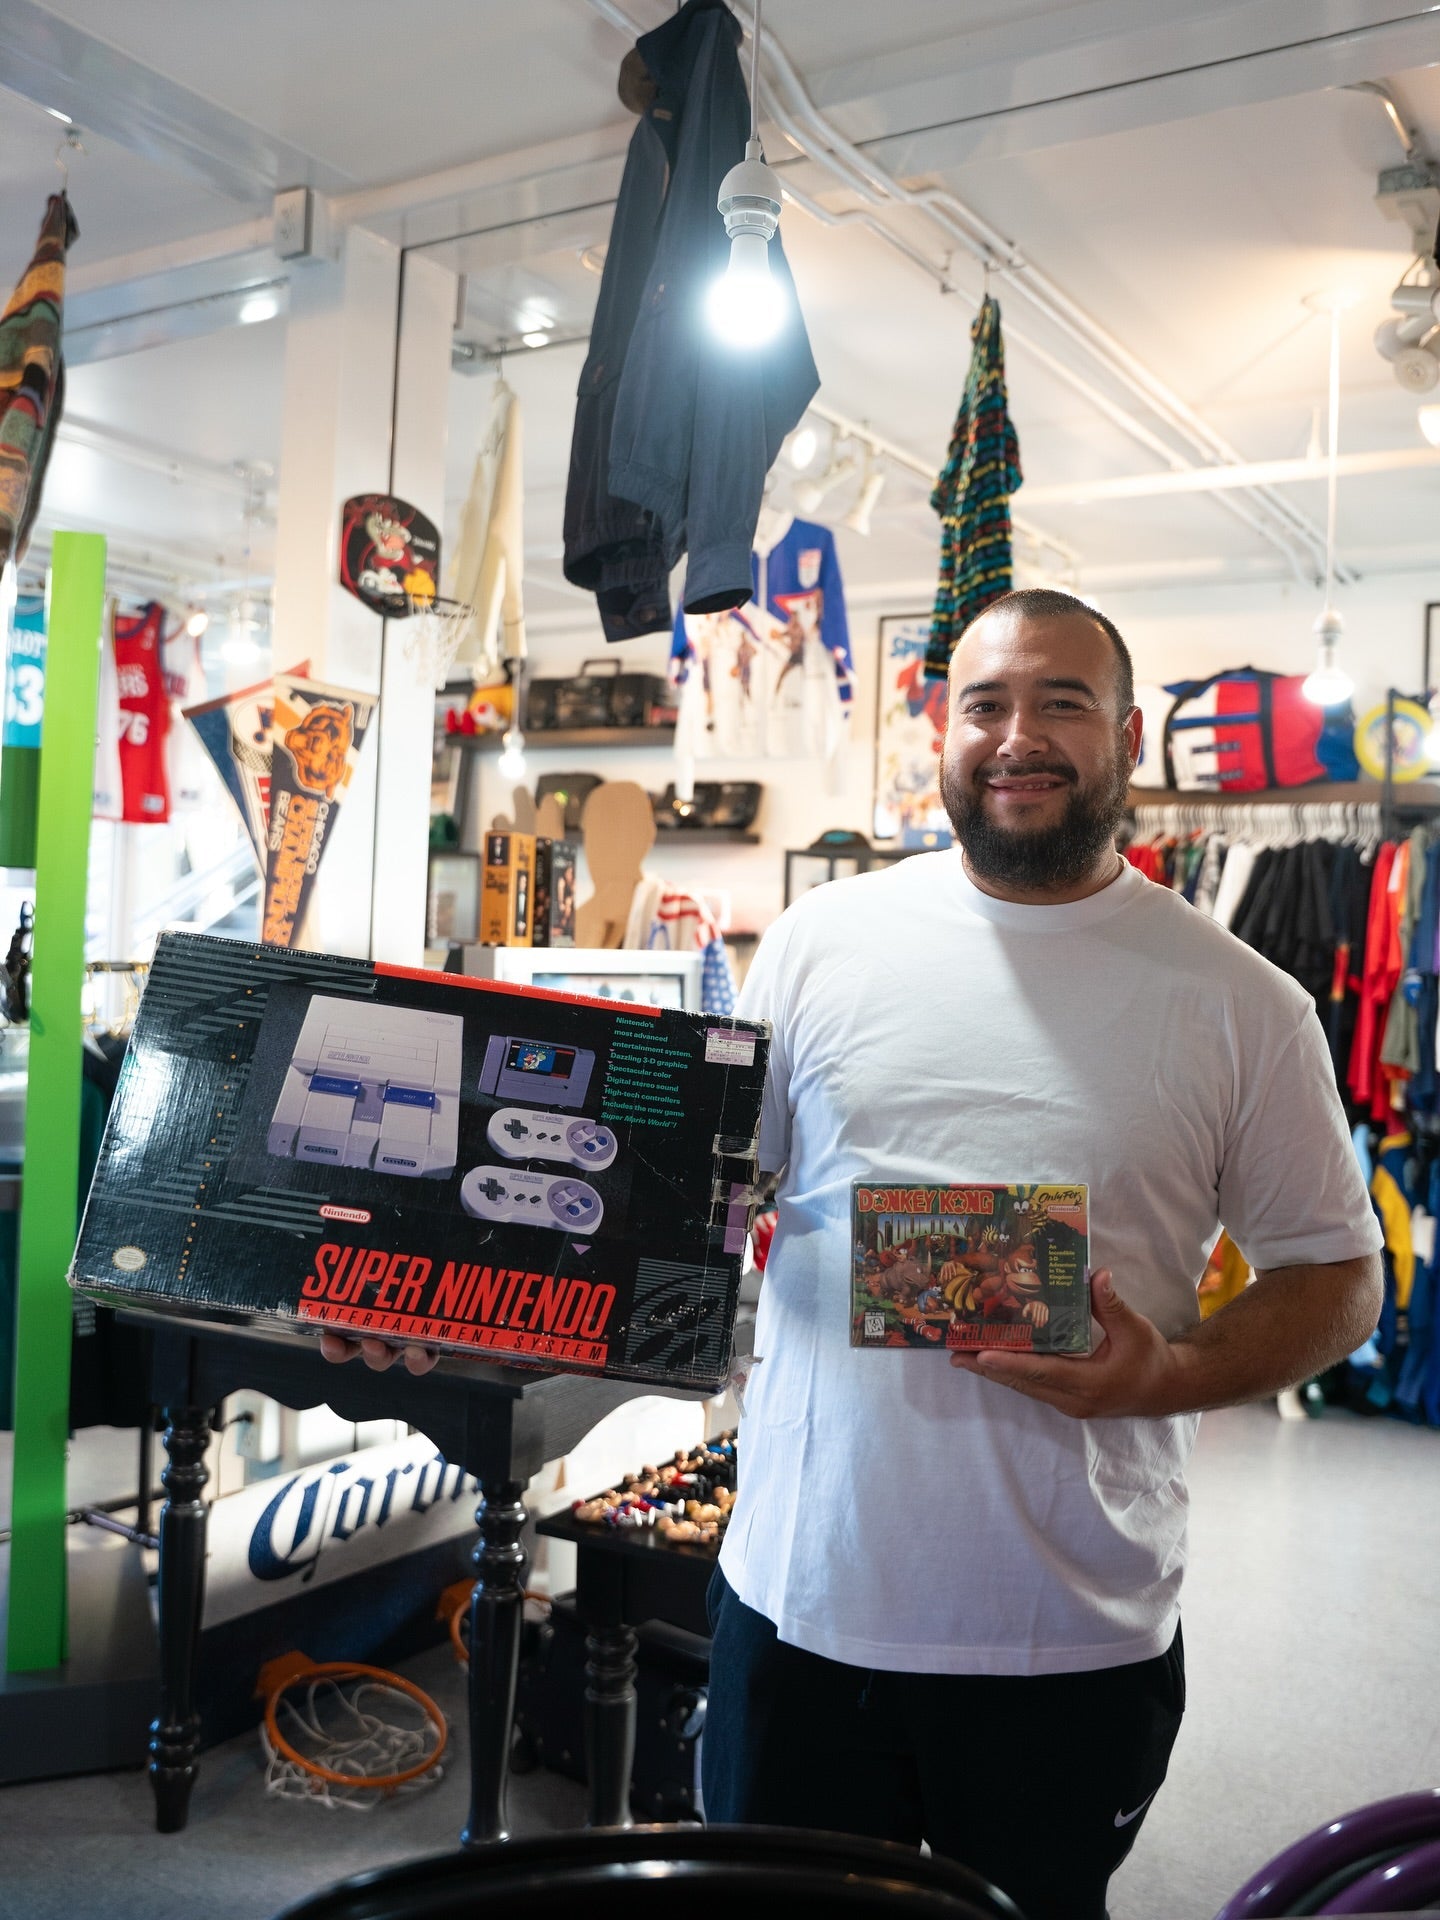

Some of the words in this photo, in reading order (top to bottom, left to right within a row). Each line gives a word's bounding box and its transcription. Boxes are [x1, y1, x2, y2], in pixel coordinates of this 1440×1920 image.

[267, 789, 292, 852] BEARS
[306, 801, 330, 875] CHICAGO
[615, 1017, 655, 1028] Nintendo's
[633, 1032, 669, 1043] advanced
[612, 1041, 664, 1054] entertainment
[664, 1049, 693, 1059] system.
[610, 1052, 642, 1063] Dazzling
[656, 1060, 688, 1070] graphics
[608, 1063, 652, 1076] Spectacular
[652, 1071, 672, 1079] color
[606, 1075, 631, 1085] Digital
[631, 1080, 655, 1089] stereo
[655, 1083, 679, 1092] sound
[604, 1087, 640, 1099] High-tech
[641, 1094, 681, 1104] controllers
[601, 1111, 626, 1121] Super
[624, 1115, 646, 1124] Mario
[602, 1100, 633, 1110] Includes
[634, 1104, 647, 1112] the
[664, 1110, 685, 1118] game
[857, 1188, 938, 1213] DONKEY
[939, 1190, 994, 1215] KONG
[1038, 1192, 1063, 1204] Only
[322, 1206, 370, 1221] Nintendo
[877, 1214, 970, 1253] COUNTRY
[301, 1243, 433, 1312] SUPER
[429, 1261, 617, 1340] NINTENDO
[303, 1303, 499, 1347] ENTERTAINMENT
[514, 1336, 603, 1362] SYSTEM
[946, 1324, 980, 1339] SUPER
[981, 1324, 1033, 1340] NINTENDO
